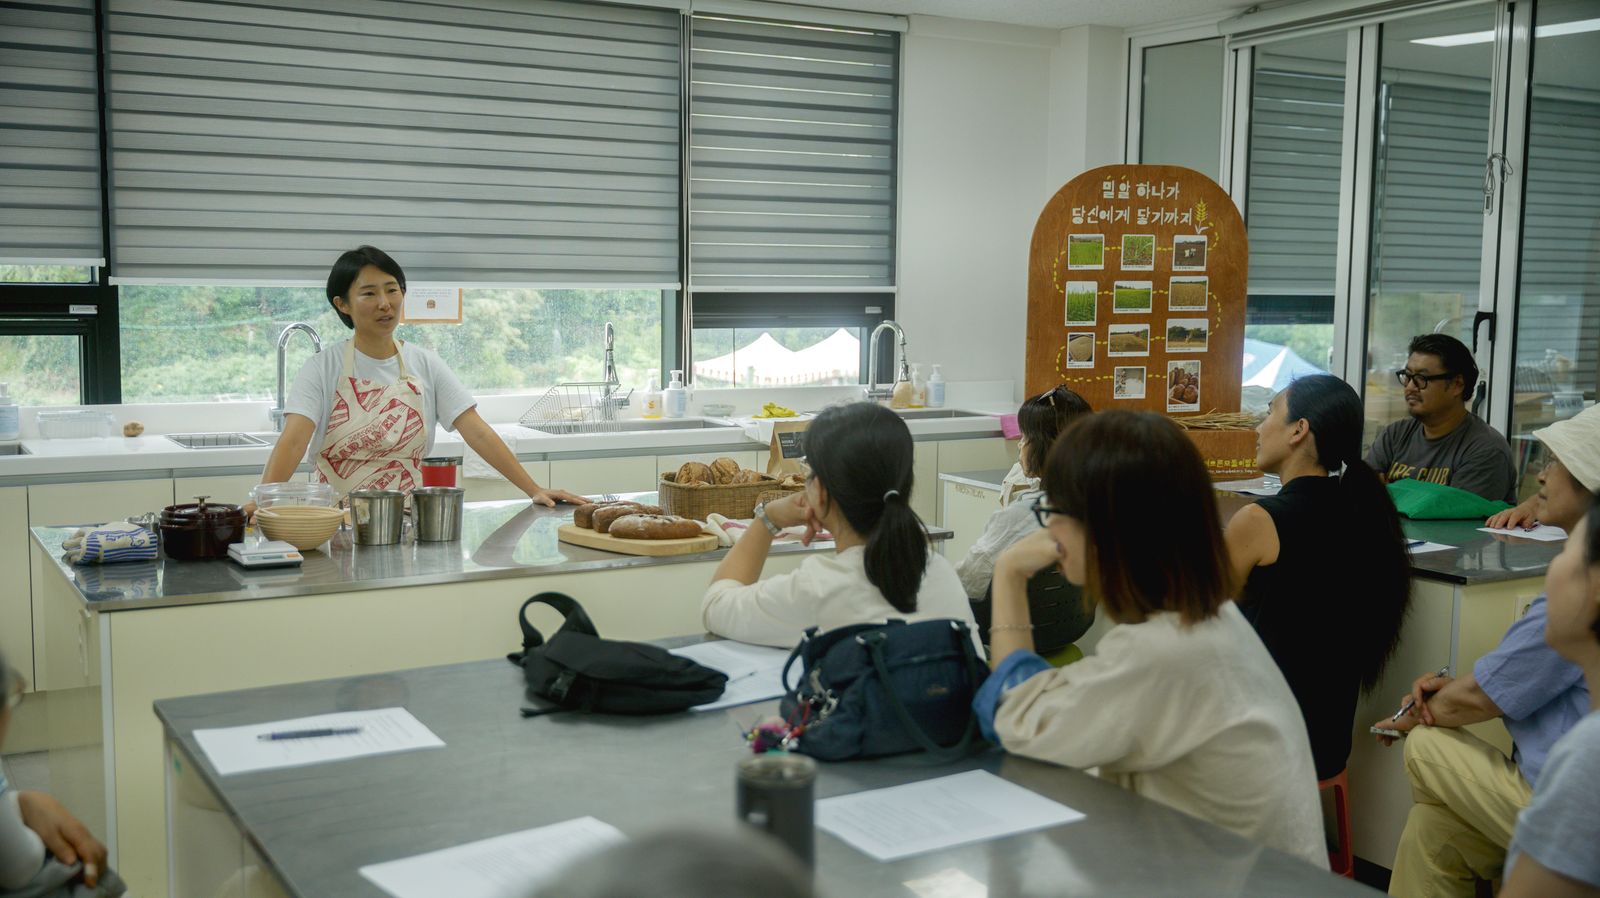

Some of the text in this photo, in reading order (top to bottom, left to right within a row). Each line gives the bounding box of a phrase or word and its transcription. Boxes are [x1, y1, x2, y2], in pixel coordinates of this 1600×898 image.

[1103, 180, 1180, 200] 밀알 하나가
[1072, 205, 1193, 226] 당신에게 닿기까지
